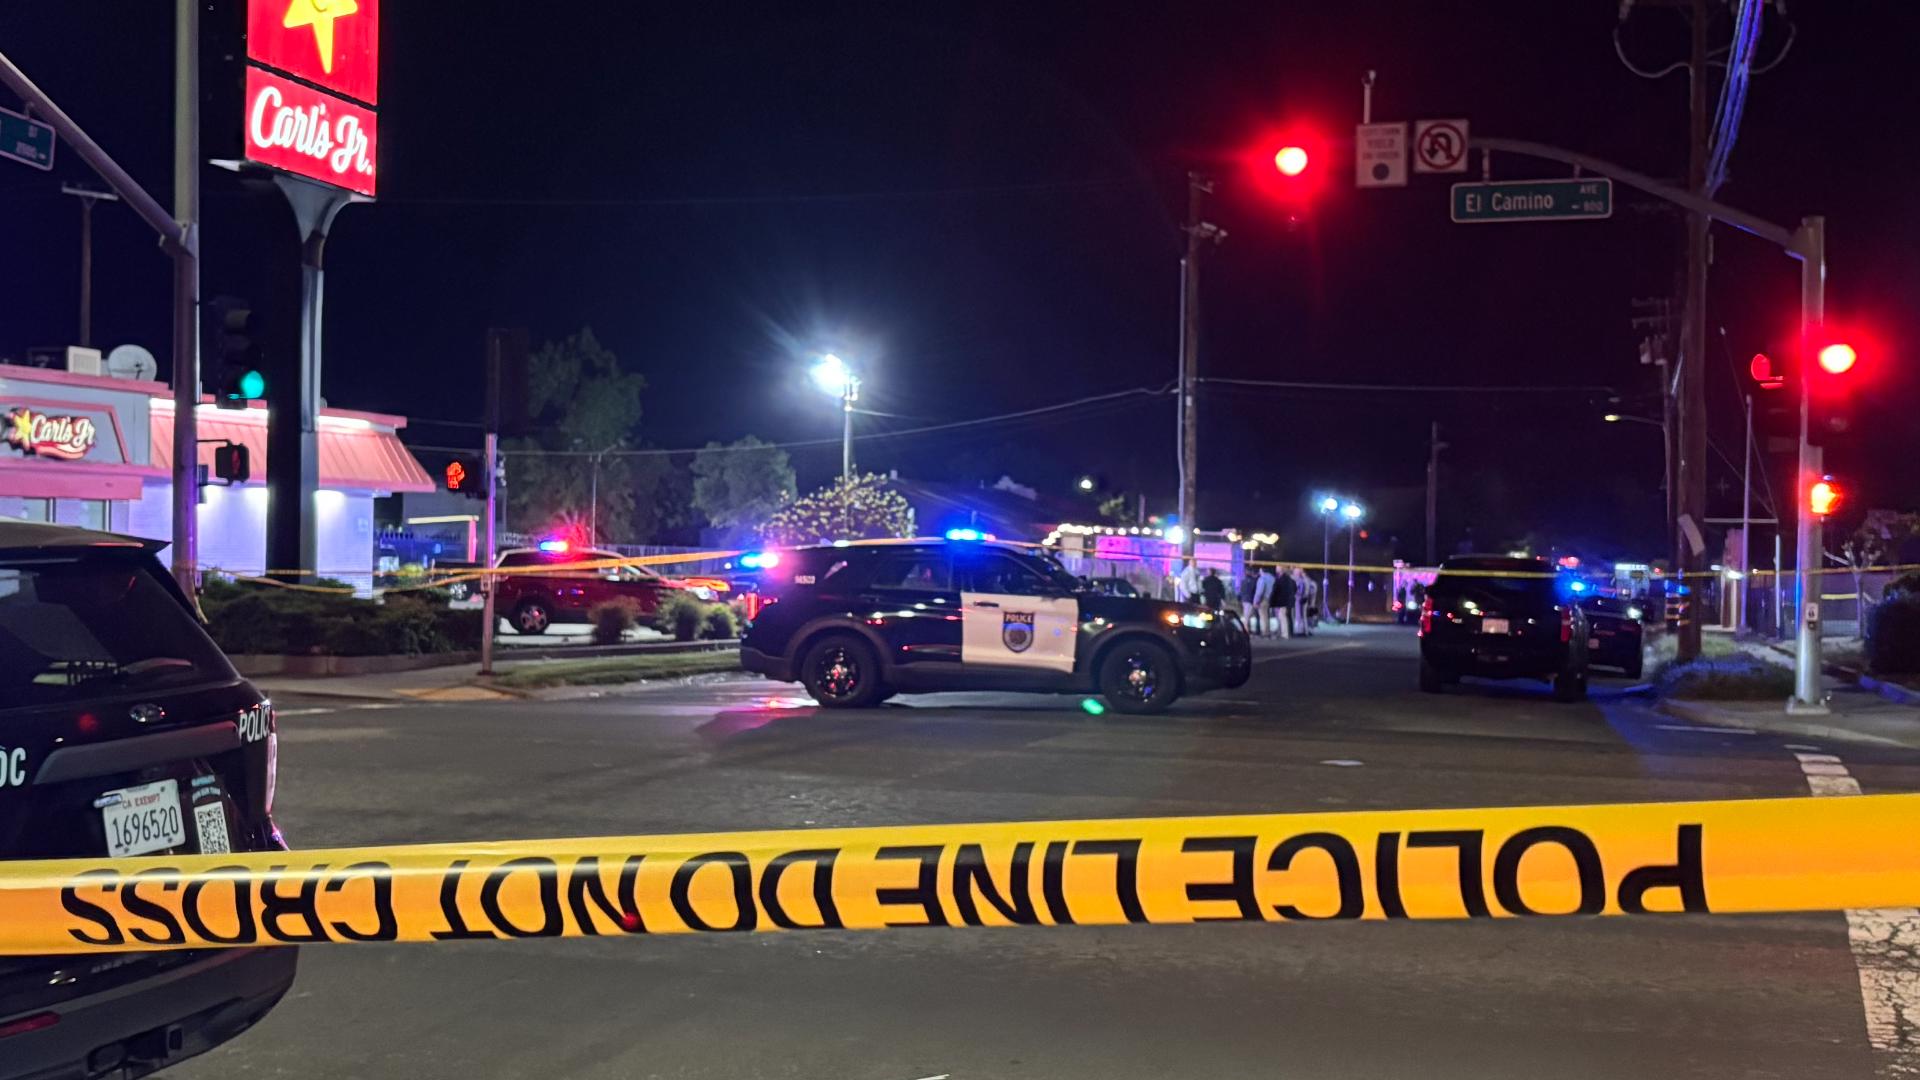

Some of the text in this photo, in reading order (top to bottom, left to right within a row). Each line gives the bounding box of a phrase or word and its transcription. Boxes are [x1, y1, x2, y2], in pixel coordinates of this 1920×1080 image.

[251, 86, 373, 175] Carl's Jr.
[1465, 192, 1554, 213] El Camino
[1579, 184, 1598, 194] AVE
[31, 414, 74, 444] Carl's
[1005, 614, 1032, 623] POLICE
[238, 707, 270, 743] POLIC
[134, 793, 161, 807] EXEMPT
[113, 805, 179, 849] 1696520
[60, 823, 1710, 945] POLICE LINE DO NOT CROSS
